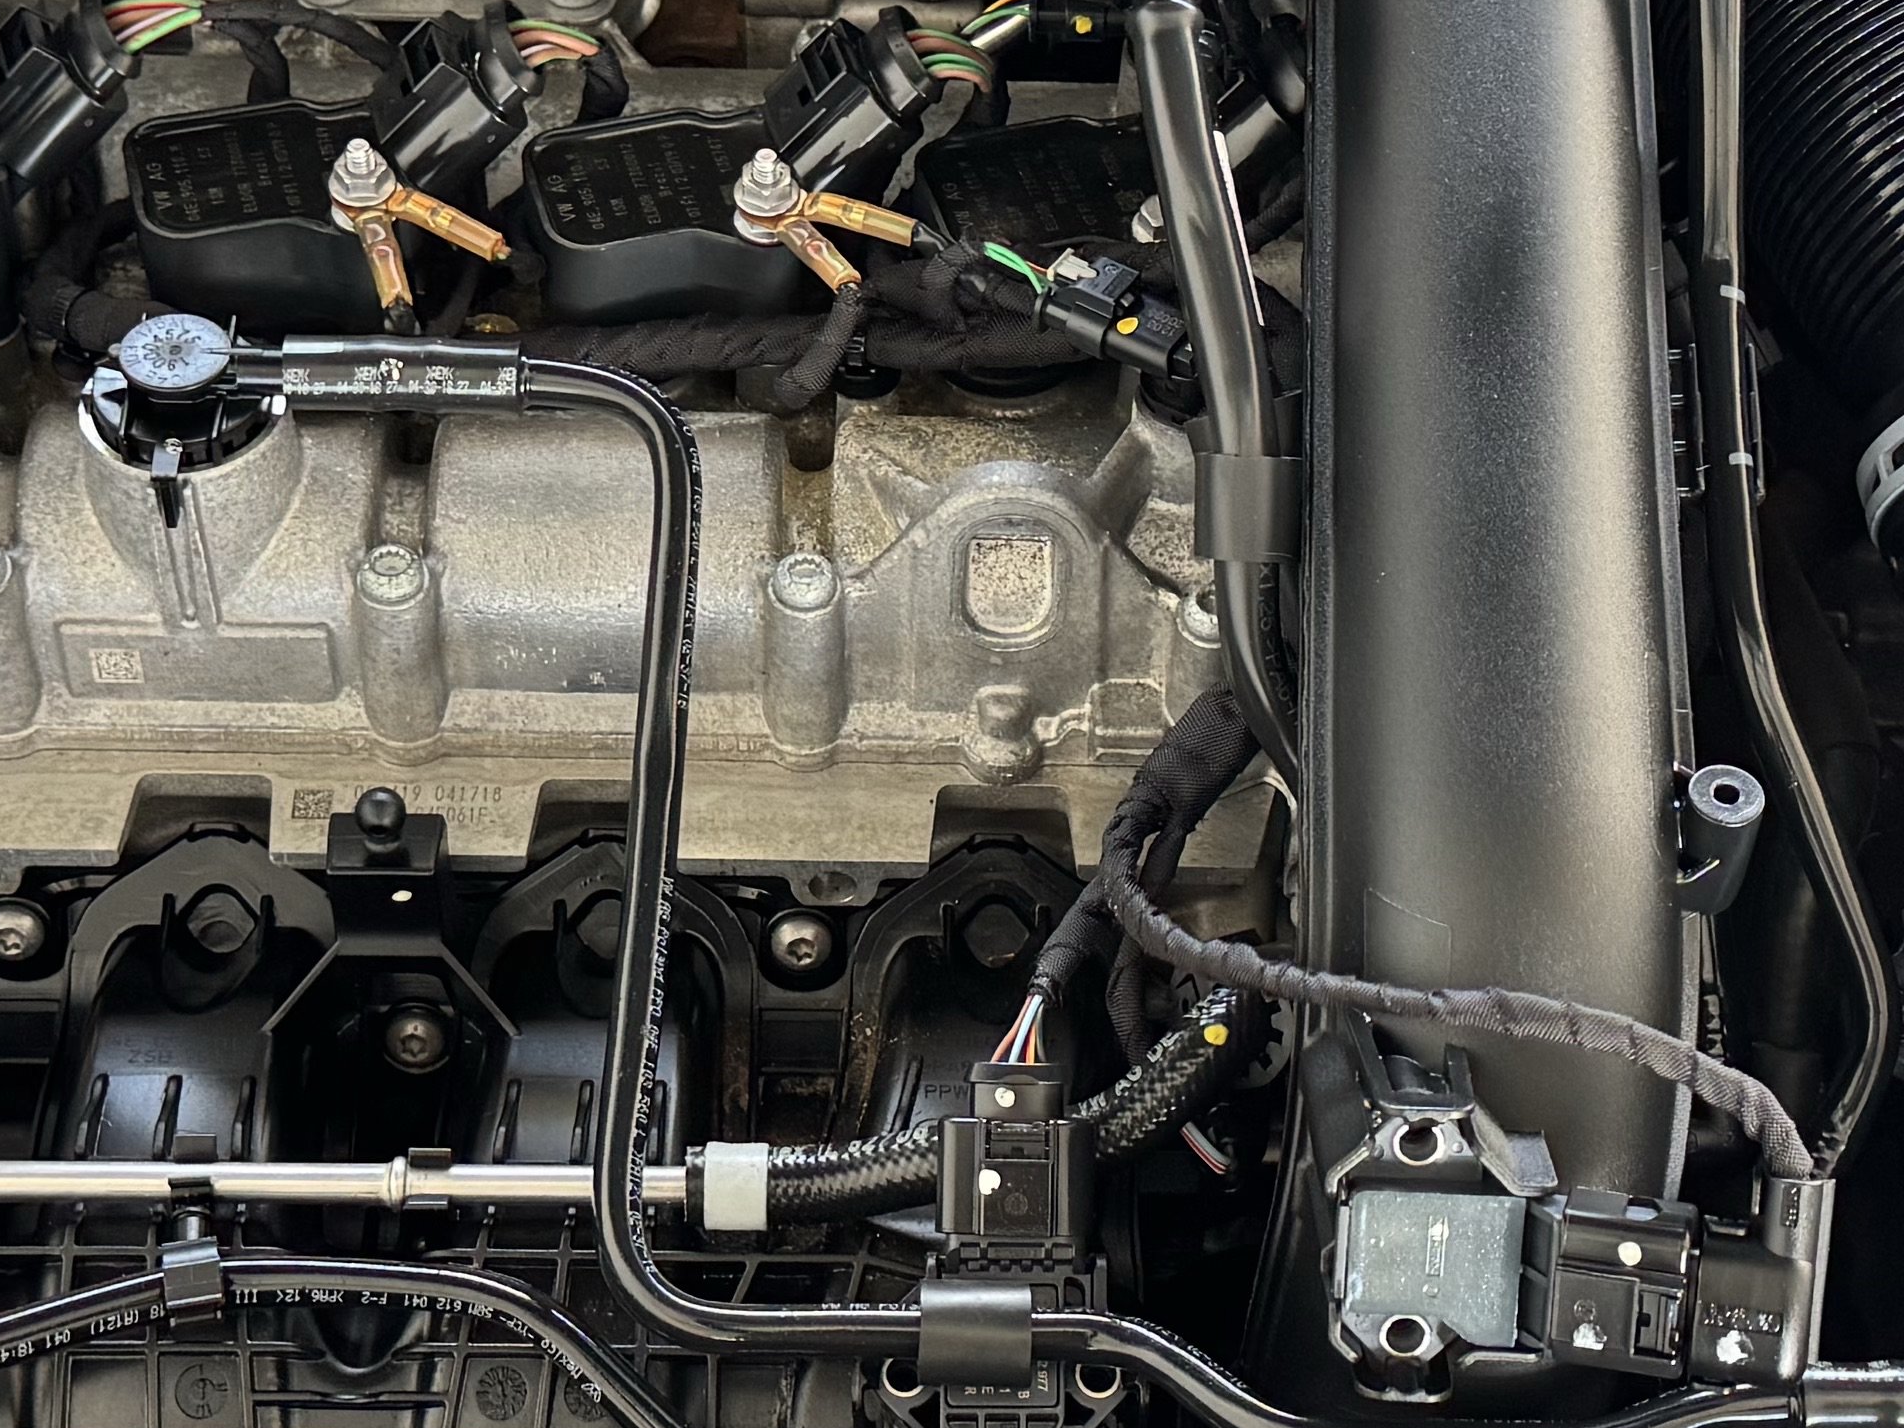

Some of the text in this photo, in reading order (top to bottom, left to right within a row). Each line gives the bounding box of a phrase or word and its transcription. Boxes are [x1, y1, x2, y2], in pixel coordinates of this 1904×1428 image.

[146, 162, 166, 180] AG
[547, 174, 576, 221] VW AG
[435, 786, 502, 802] 041718
[275, 1288, 345, 1304] >PA6.12<
[360, 1290, 387, 1304] F-2
[402, 1293, 427, 1307] 041
[435, 1295, 461, 1312] 612
[44, 1328, 70, 1347] 041
